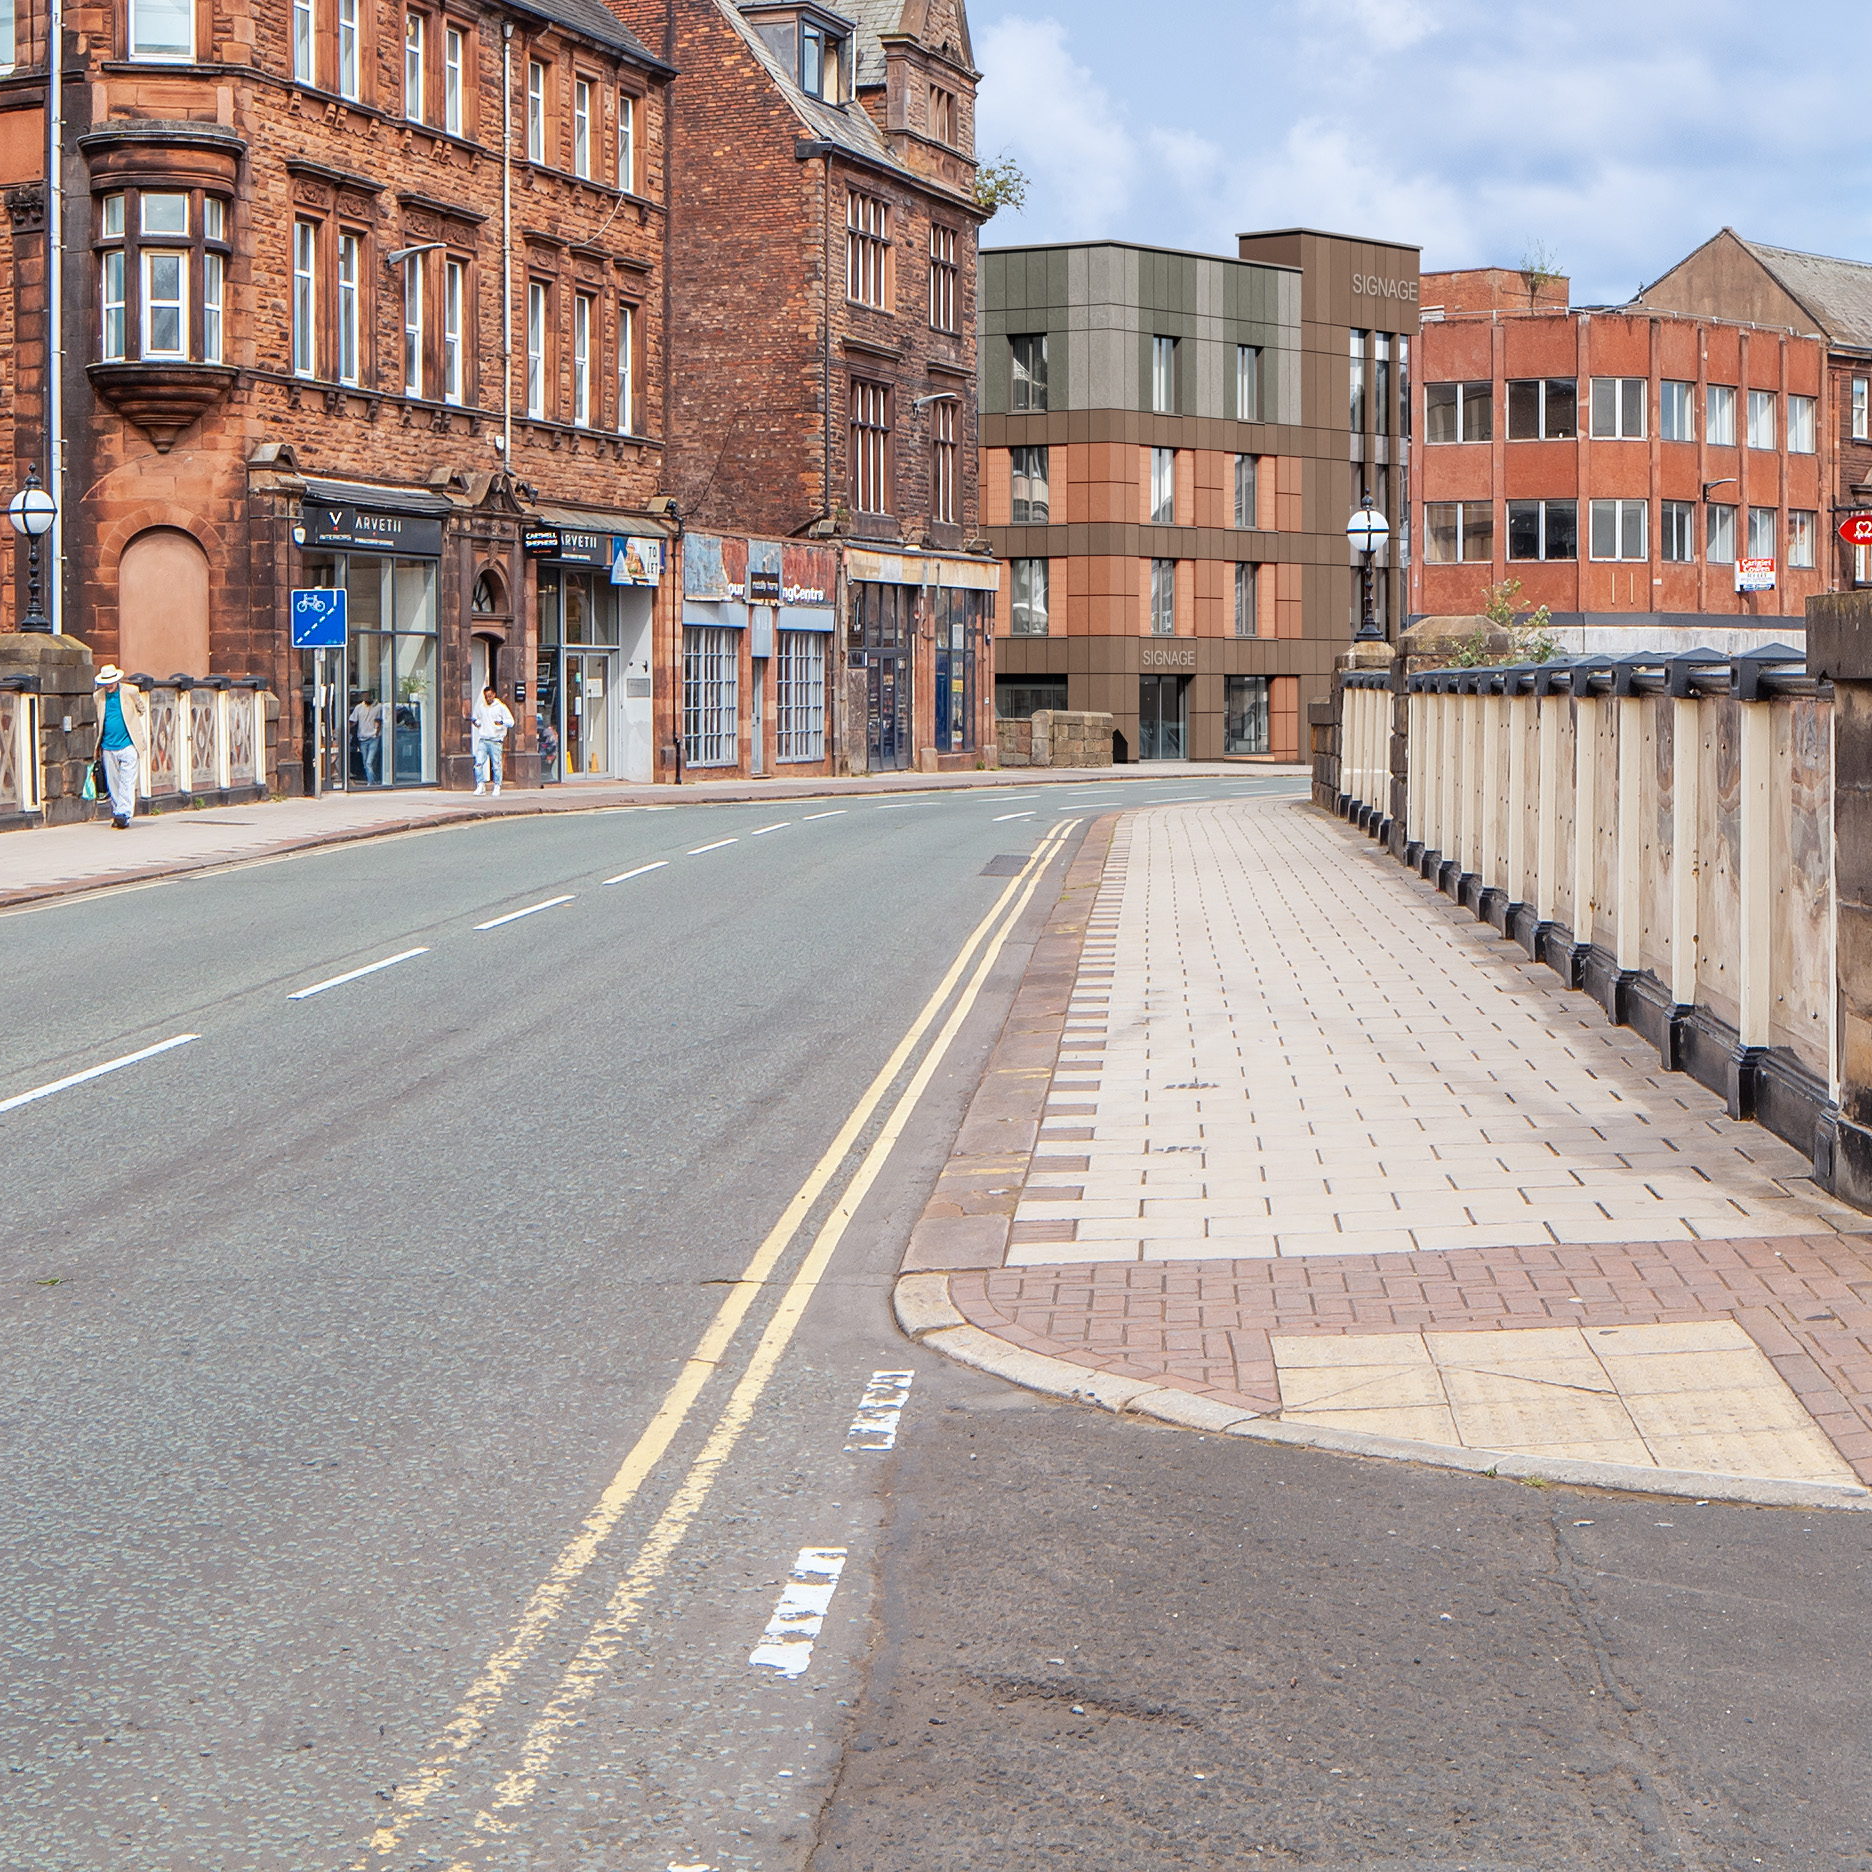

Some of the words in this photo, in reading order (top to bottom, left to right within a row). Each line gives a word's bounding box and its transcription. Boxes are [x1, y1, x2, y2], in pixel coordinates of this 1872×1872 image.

[1352, 273, 1418, 302] SIGNAGE
[648, 546, 658, 558] TO
[646, 562, 658, 574] LET
[1142, 650, 1196, 666] SIGNAGE
